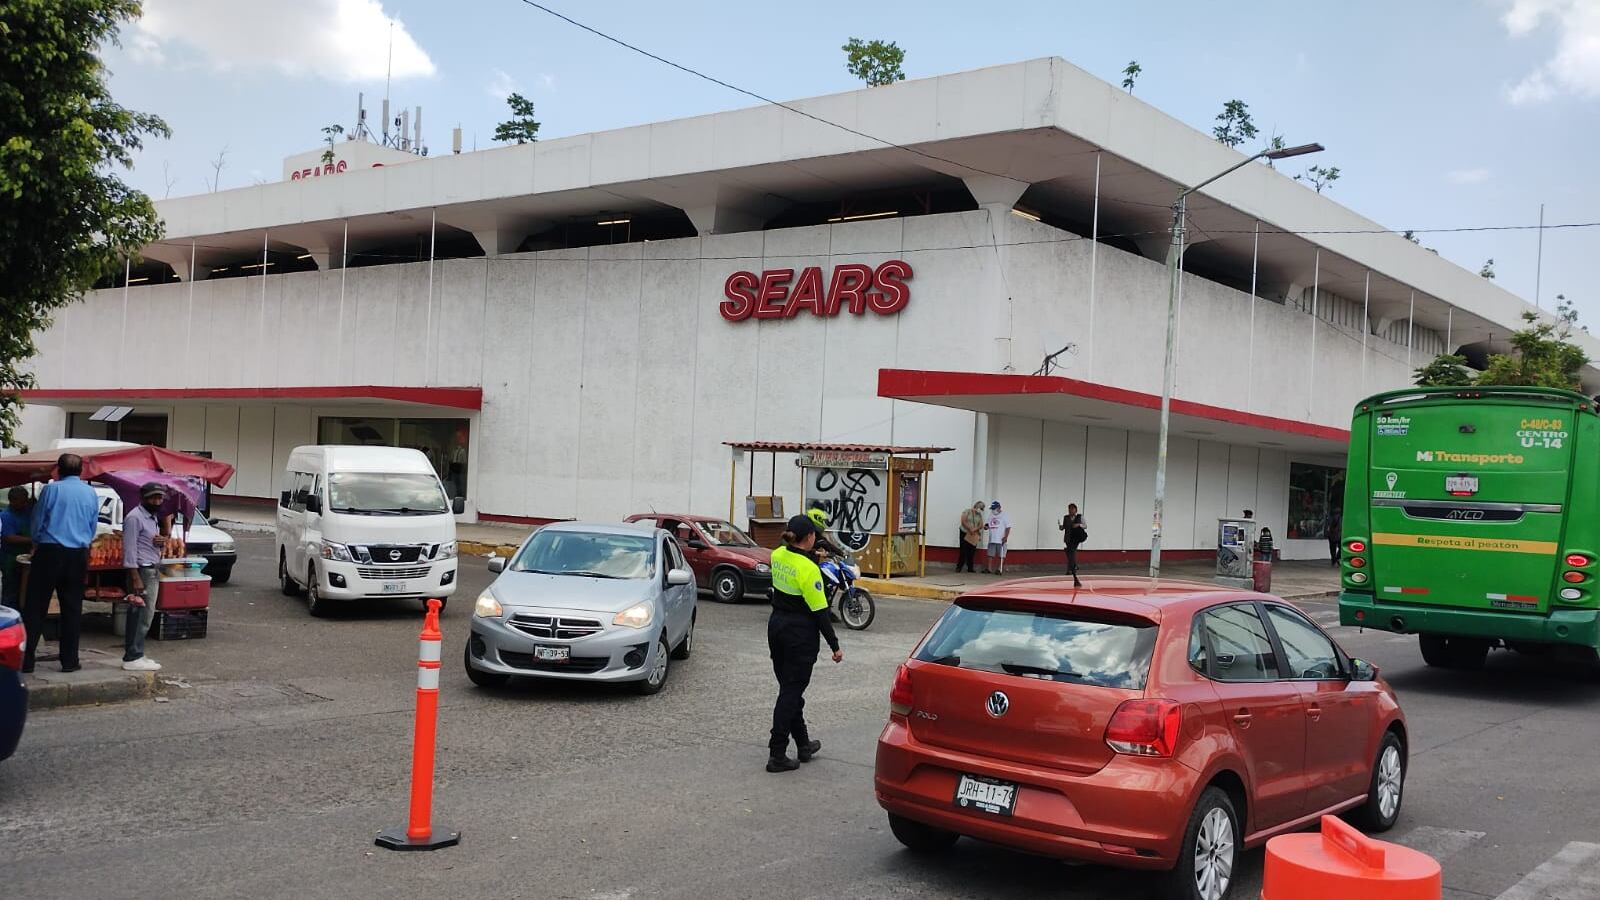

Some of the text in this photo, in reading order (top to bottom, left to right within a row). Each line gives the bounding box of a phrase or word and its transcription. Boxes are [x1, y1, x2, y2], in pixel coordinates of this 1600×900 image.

[719, 259, 914, 322] SEARS
[1516, 430, 1568, 438] CENTRO
[1521, 437, 1562, 448] U-14
[1416, 450, 1524, 465] Mi Transporte
[1417, 537, 1460, 546] Respeta
